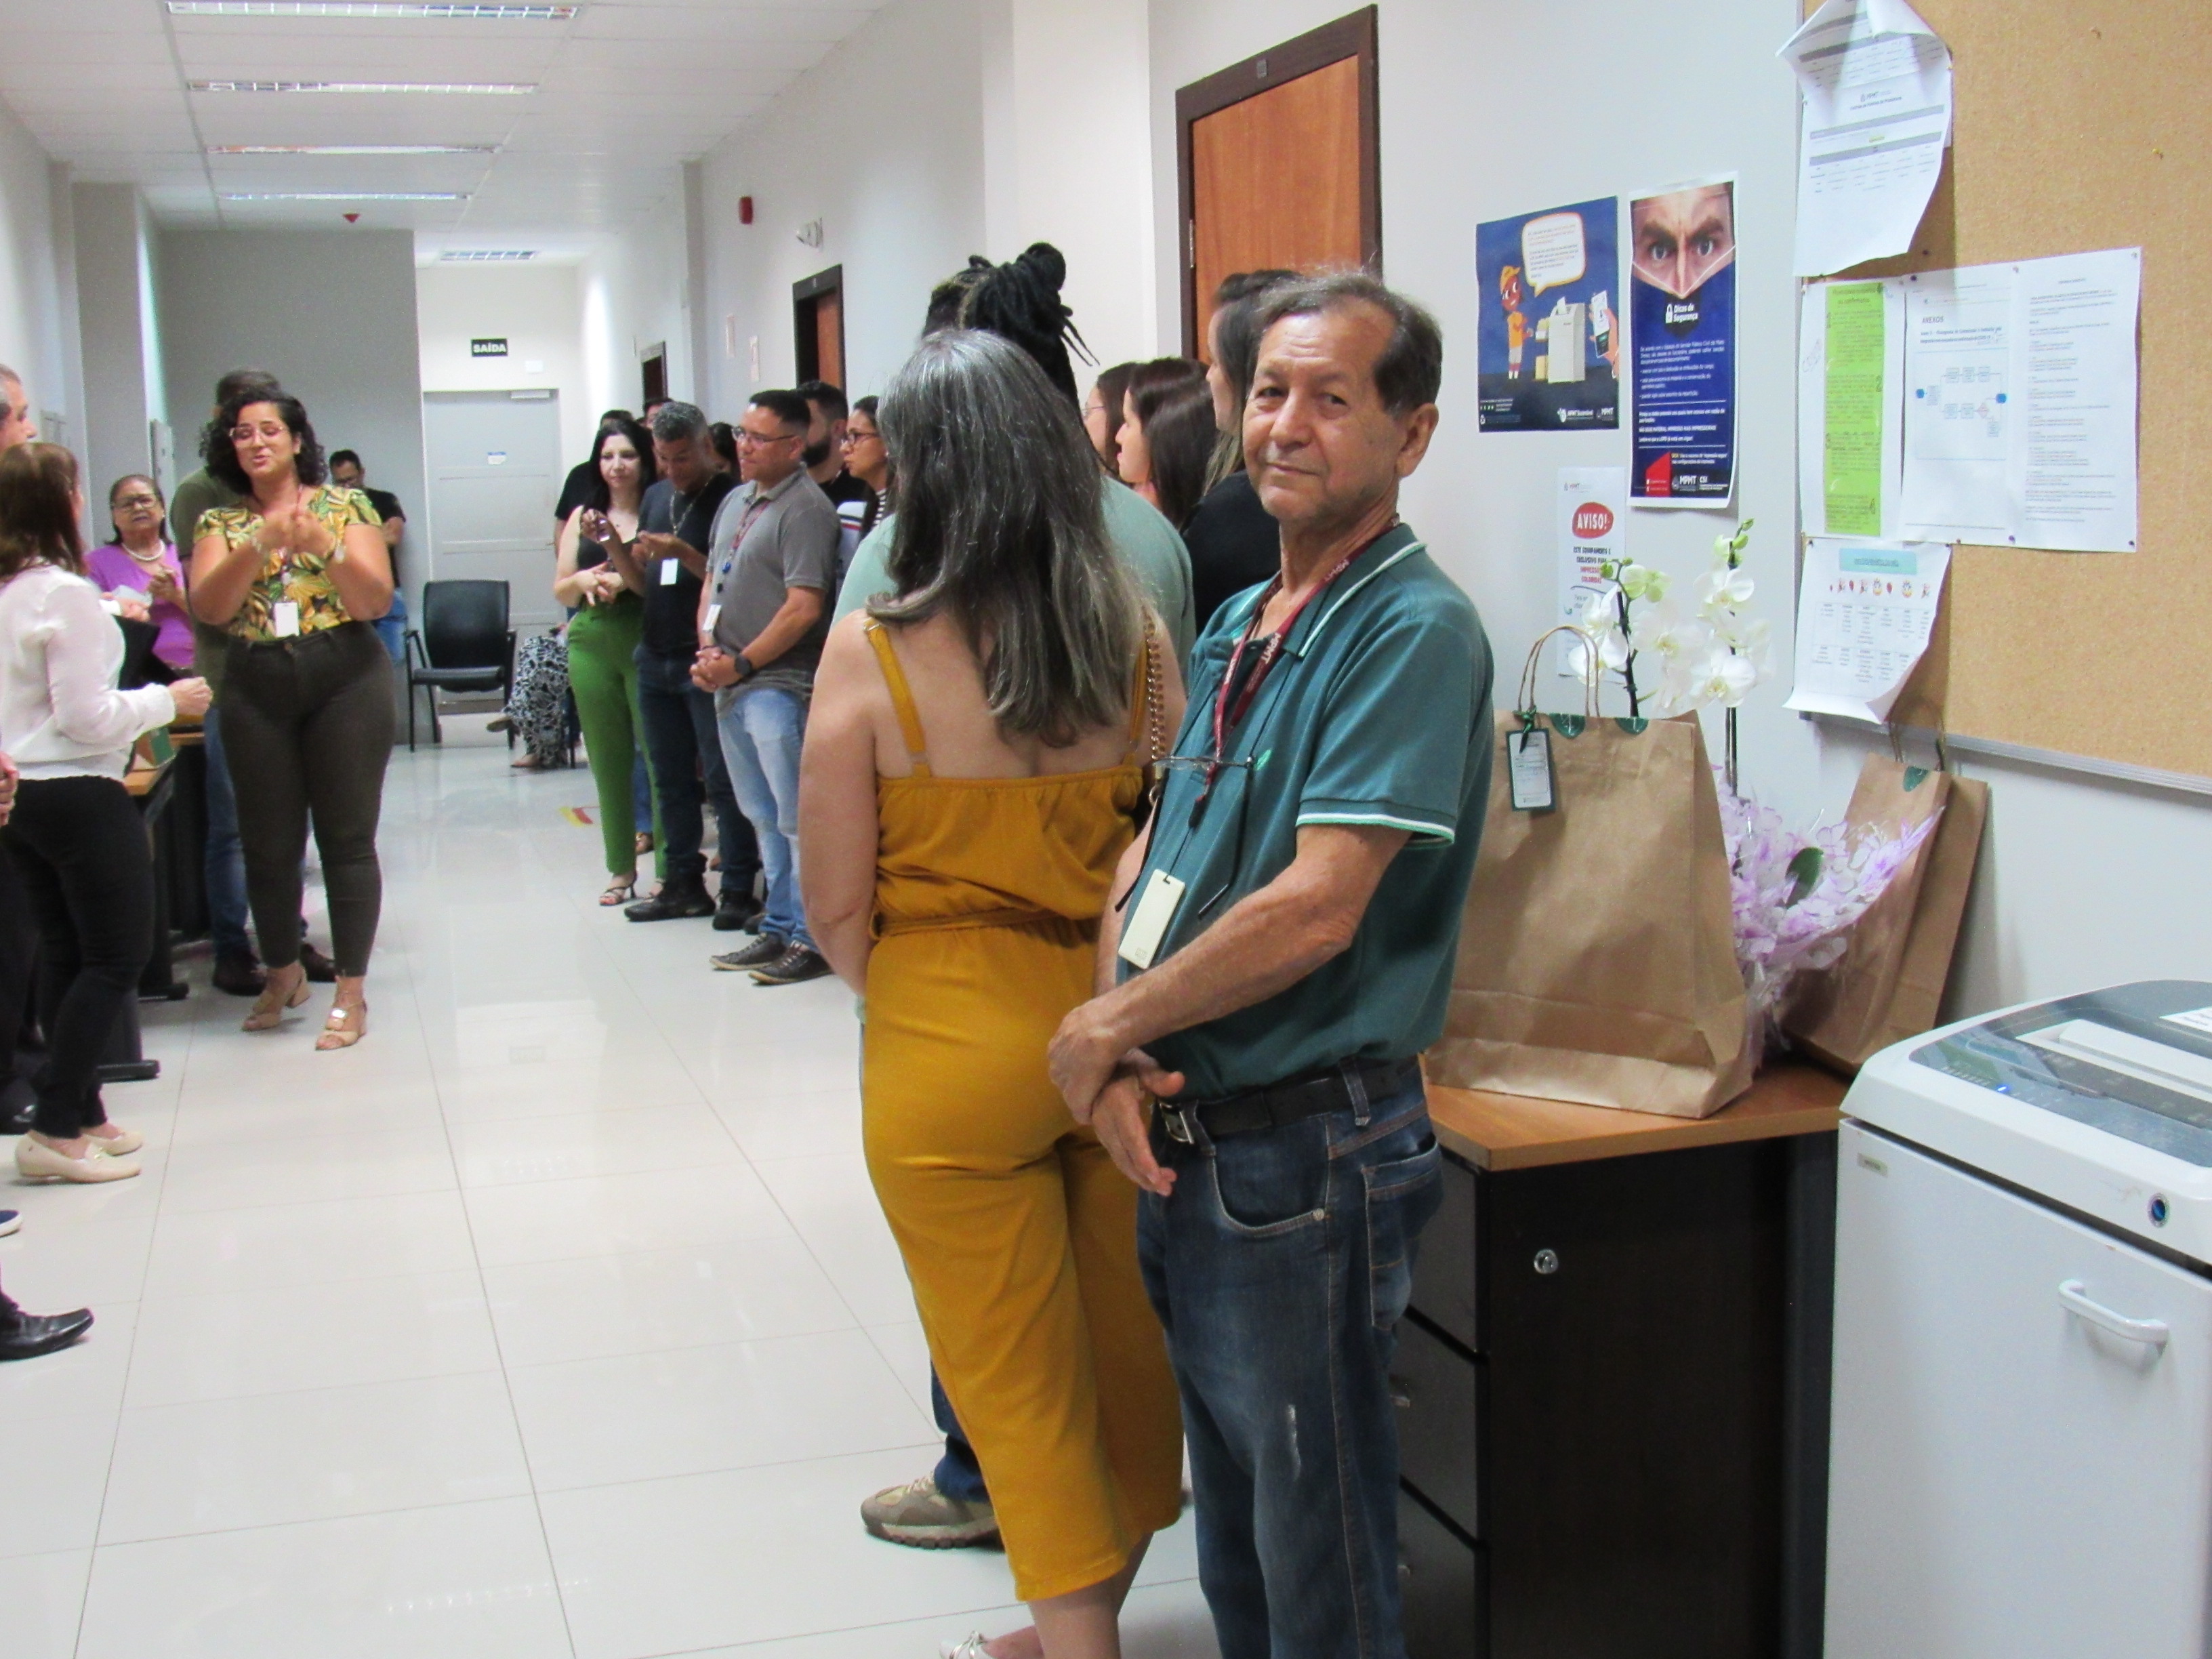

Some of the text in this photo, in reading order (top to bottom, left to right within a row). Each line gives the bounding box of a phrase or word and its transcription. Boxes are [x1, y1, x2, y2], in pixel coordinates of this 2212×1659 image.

[1673, 304, 1694, 313] Dicas de
[1673, 312, 1698, 323] Segurança
[473, 342, 506, 353] SAÍDA
[1679, 475, 1697, 485] MPMT
[1577, 514, 1607, 530] AVISO!
[1261, 632, 1282, 665] MPMT
